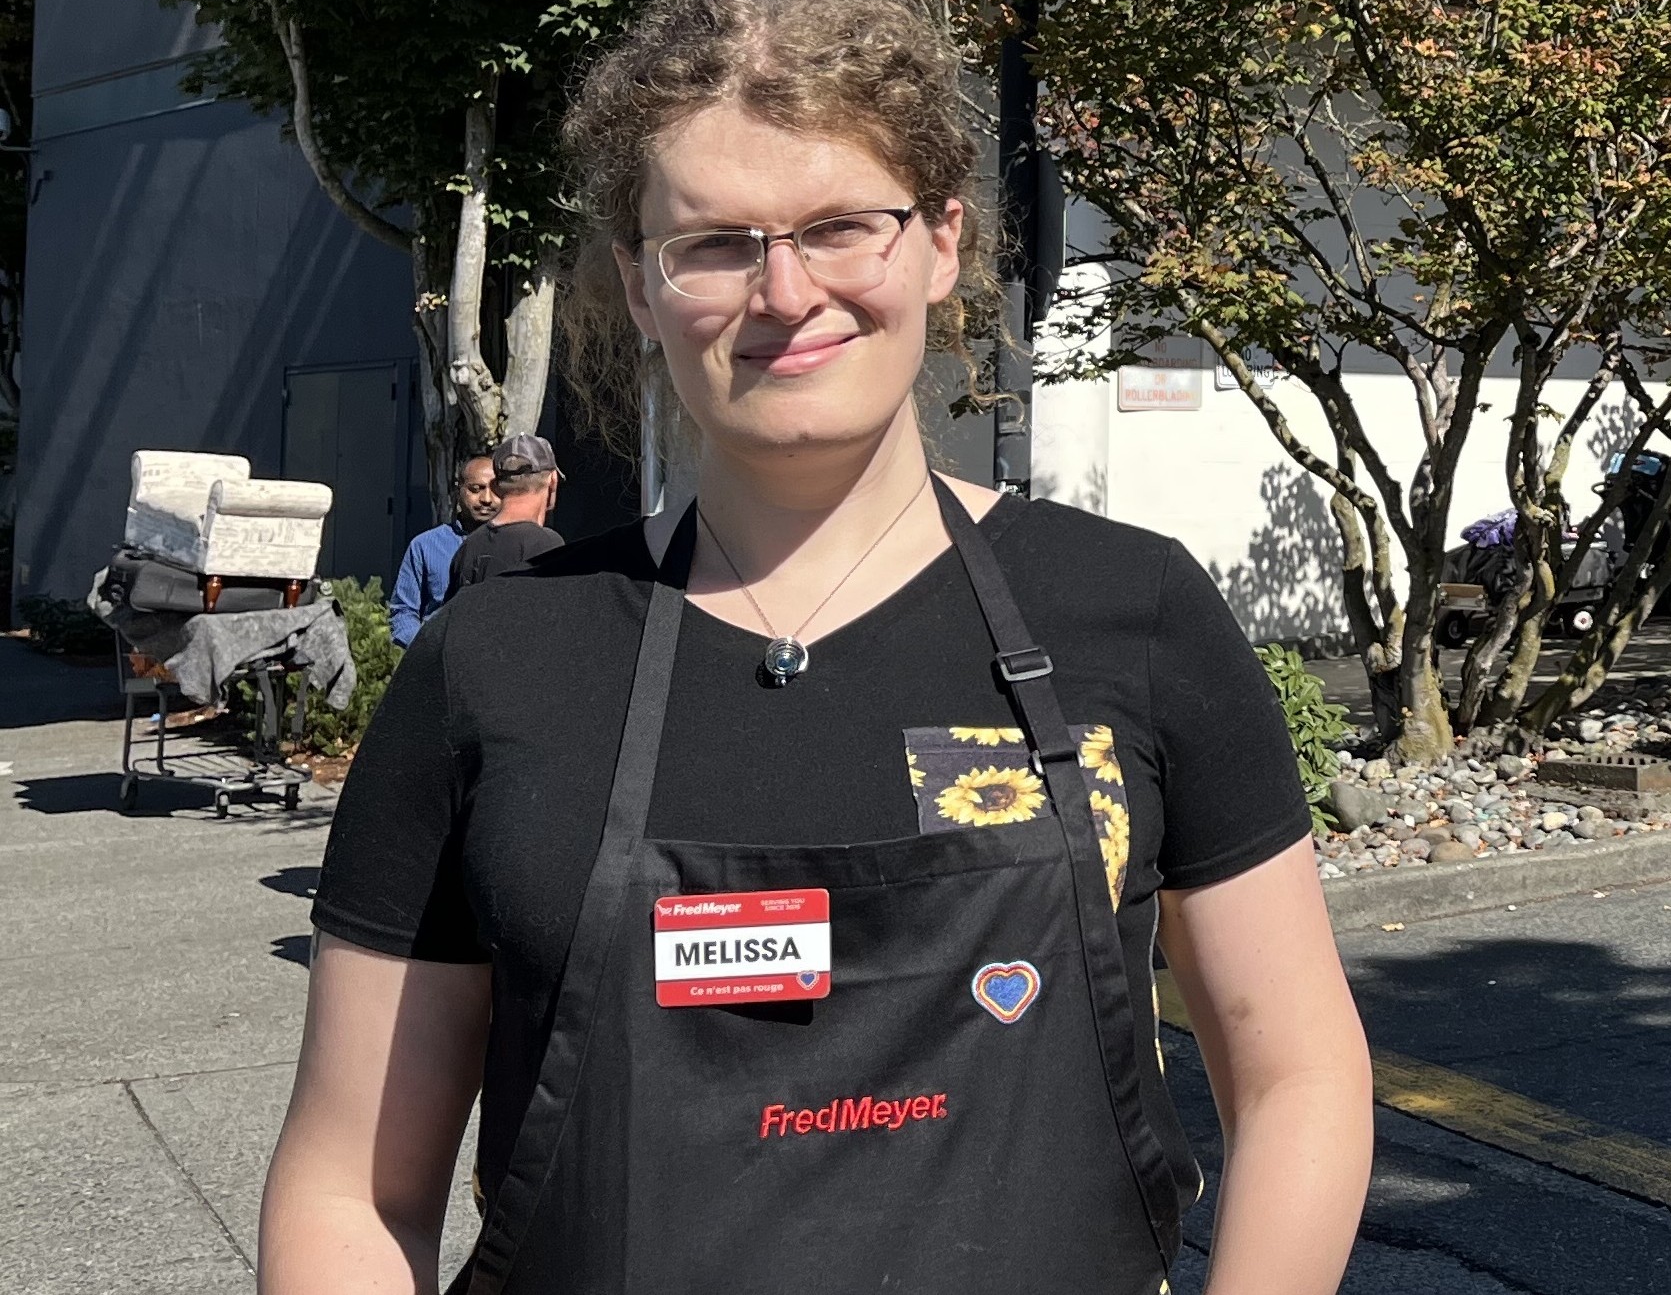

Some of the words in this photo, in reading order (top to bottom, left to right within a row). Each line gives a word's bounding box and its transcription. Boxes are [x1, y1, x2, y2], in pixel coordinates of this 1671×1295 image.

[675, 936, 801, 967] MELISSA
[690, 986, 705, 996] Ce
[706, 985, 731, 995] n'est
[732, 985, 752, 995] pas
[753, 983, 784, 994] rouge
